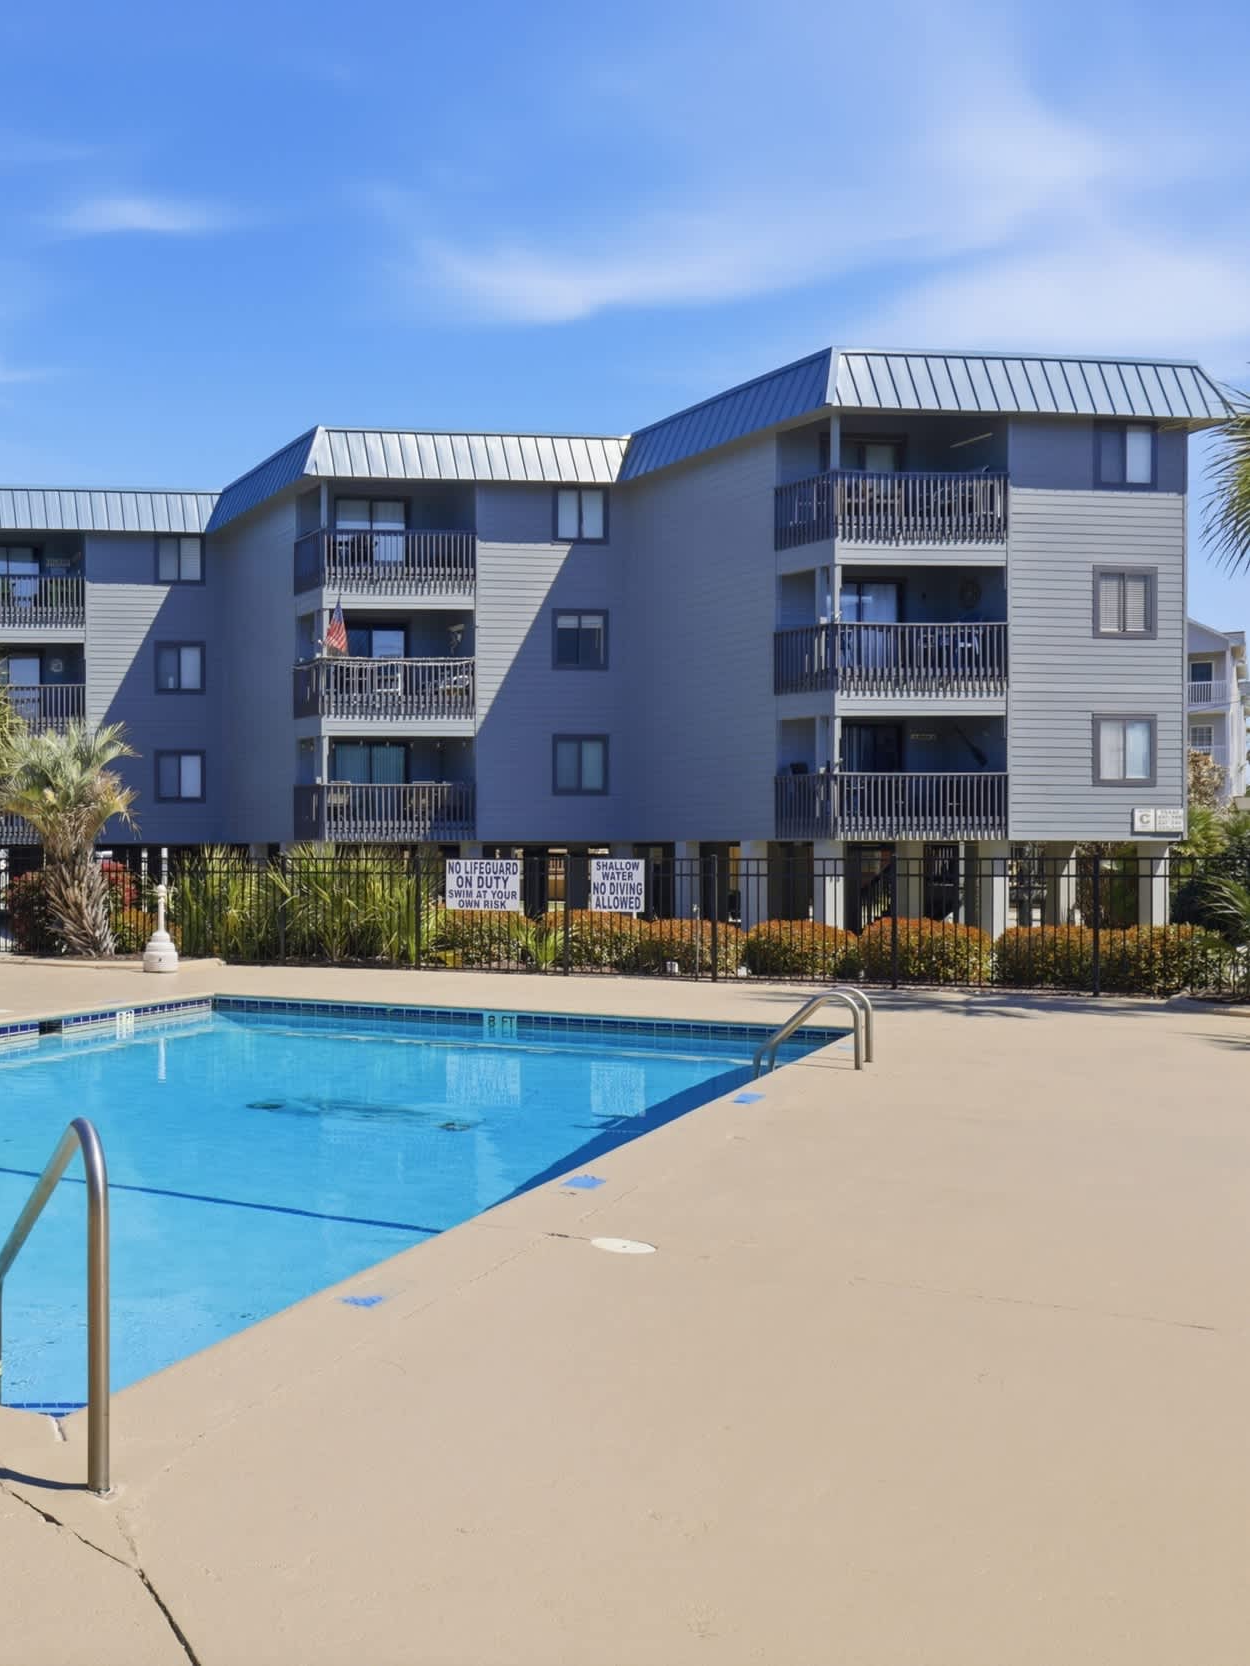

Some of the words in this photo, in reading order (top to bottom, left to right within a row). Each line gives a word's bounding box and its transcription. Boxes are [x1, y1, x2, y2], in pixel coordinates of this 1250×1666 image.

[448, 862, 461, 874] NO
[464, 862, 518, 875] LIFEGUARD
[596, 861, 640, 871] SHALLOW
[456, 875, 472, 888] ON
[477, 876, 509, 889] DUTY
[601, 871, 634, 881] WATER
[448, 889, 473, 899] SWIM
[476, 890, 488, 900] AT
[491, 890, 517, 900] YOUR
[593, 882, 607, 895] NO
[609, 882, 643, 896] DIVING
[458, 900, 480, 908] OWN
[483, 900, 506, 909] RISK
[595, 896, 641, 910] ALLOWED
[501, 1015, 516, 1028] FT
